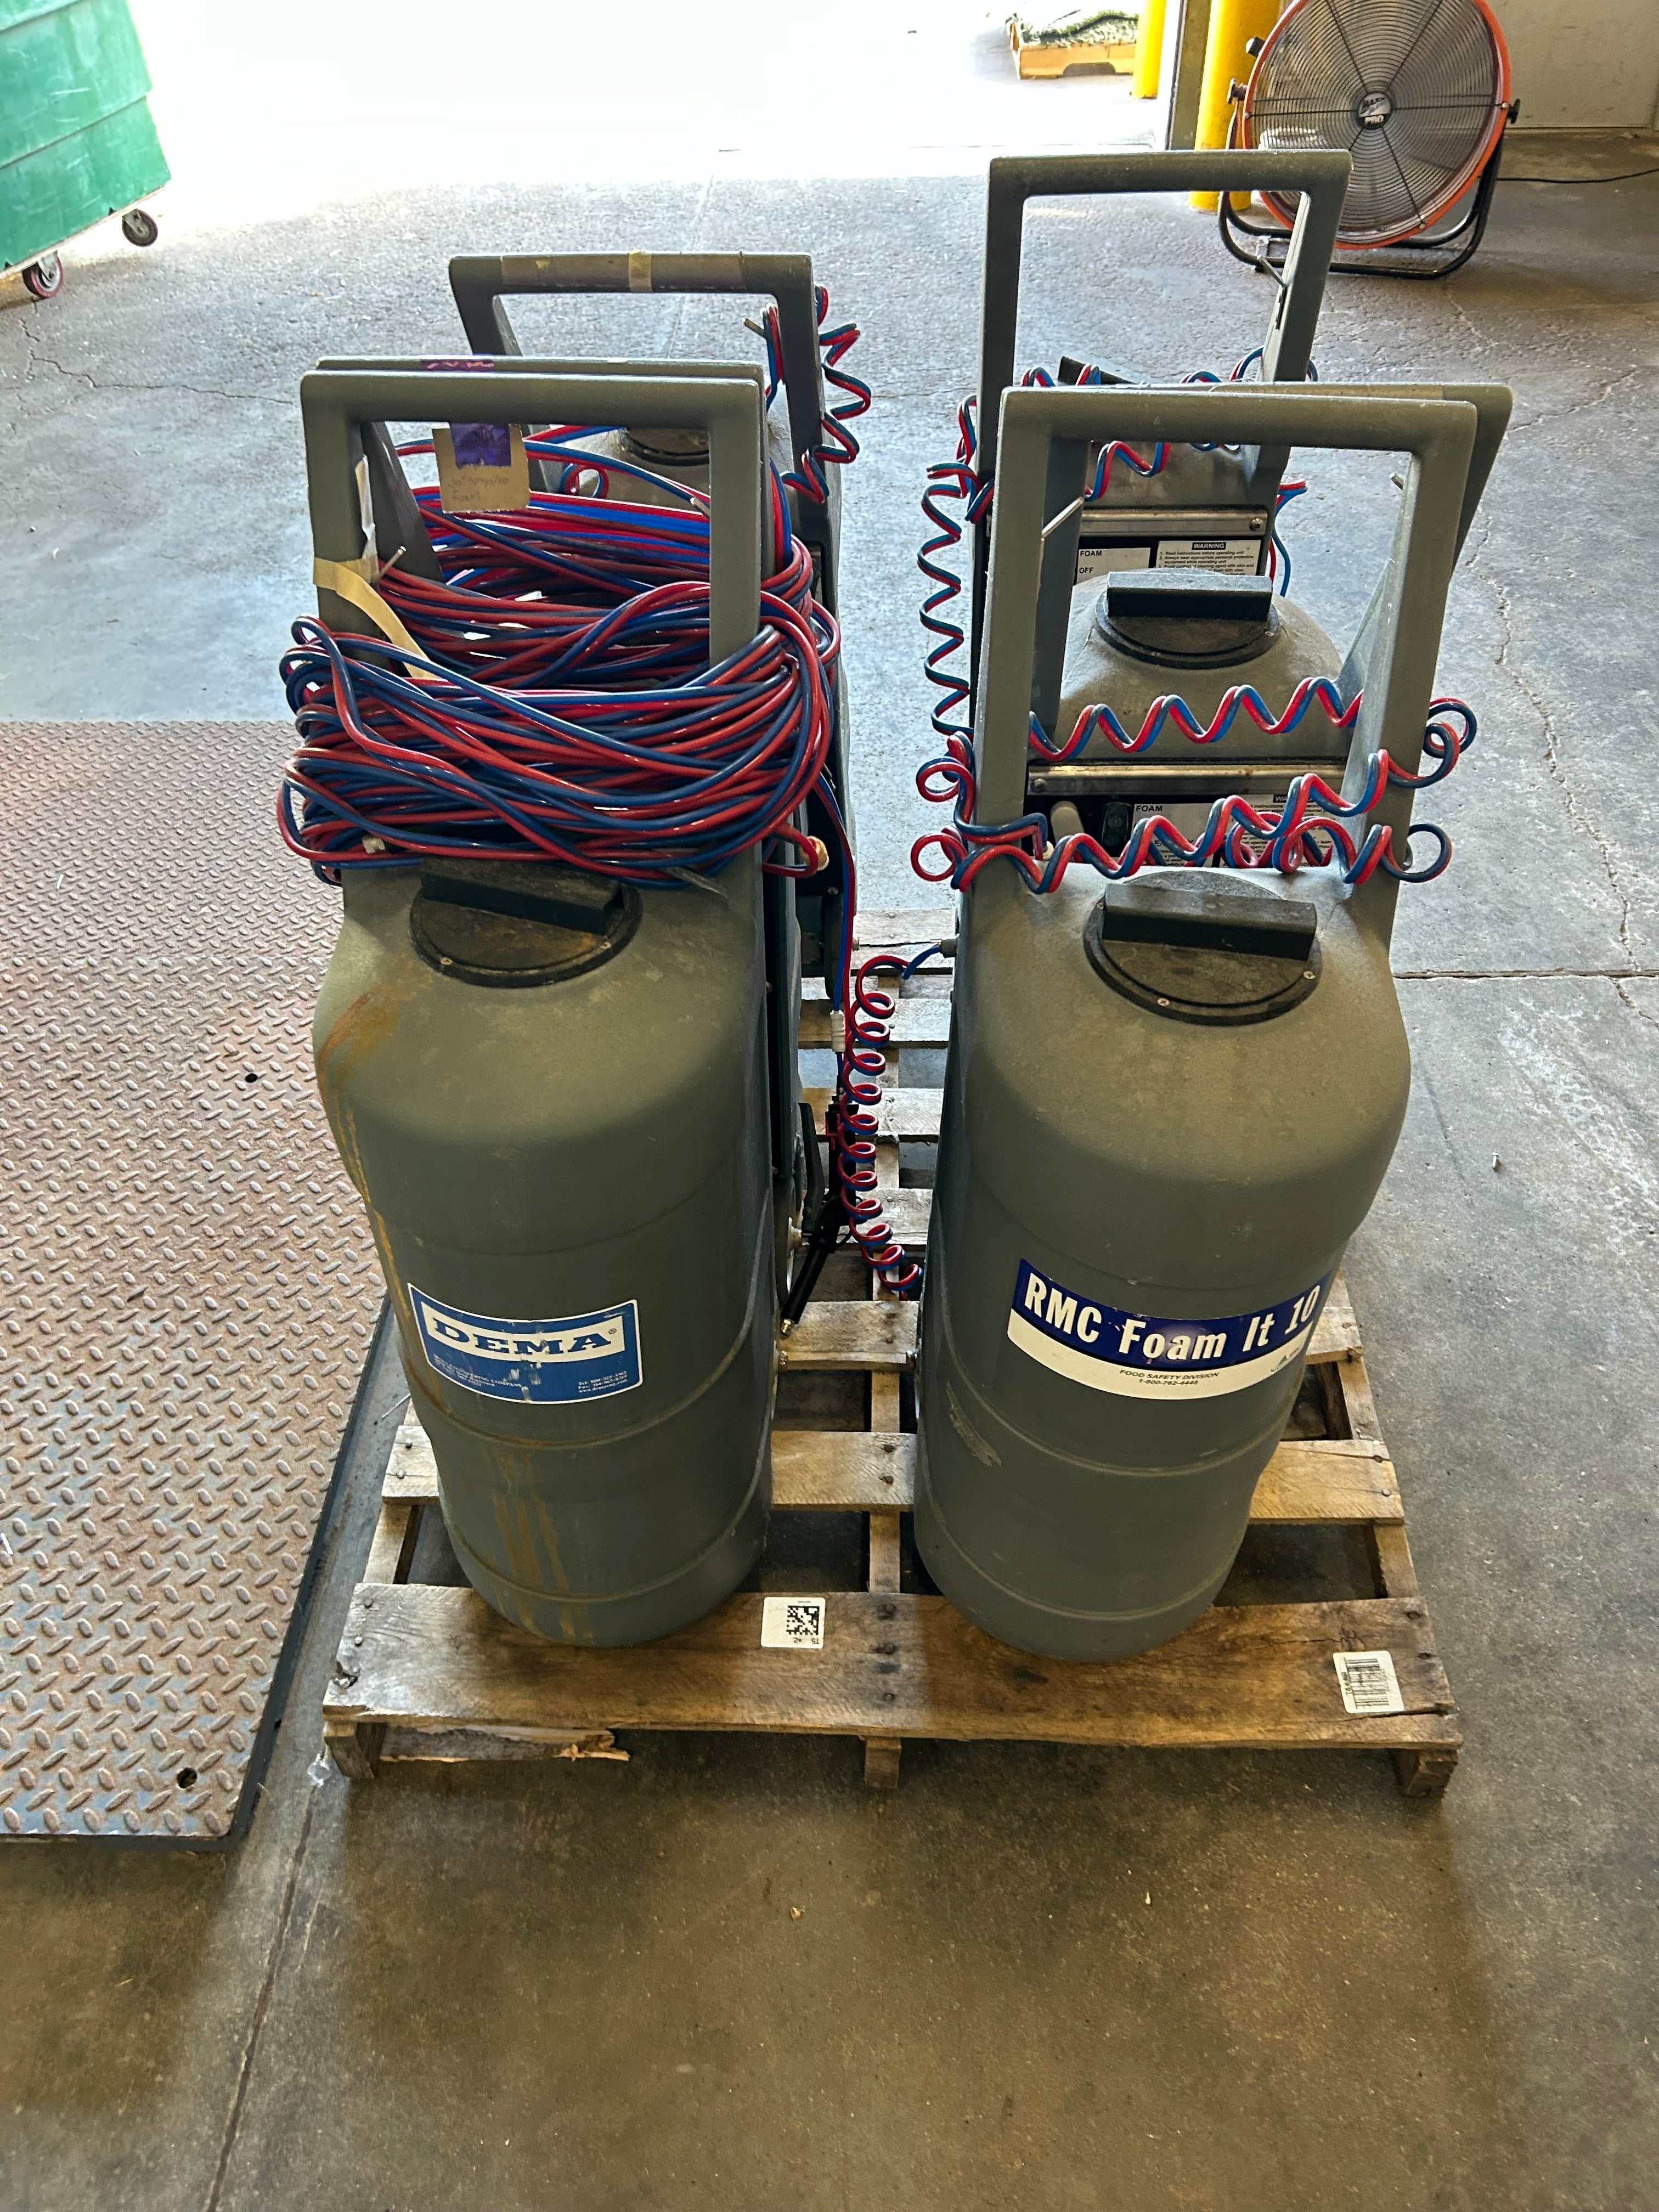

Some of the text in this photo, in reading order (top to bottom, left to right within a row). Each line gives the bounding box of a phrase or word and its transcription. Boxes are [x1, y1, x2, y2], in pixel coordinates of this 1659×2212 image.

[1024, 1272, 1102, 1343] RMC
[1119, 1319, 1227, 1360] Foam
[1242, 1313, 1275, 1352] It
[1284, 1285, 1320, 1335] 10
[432, 1317, 611, 1355] DEMA
[1119, 1369, 1146, 1378] FOOD
